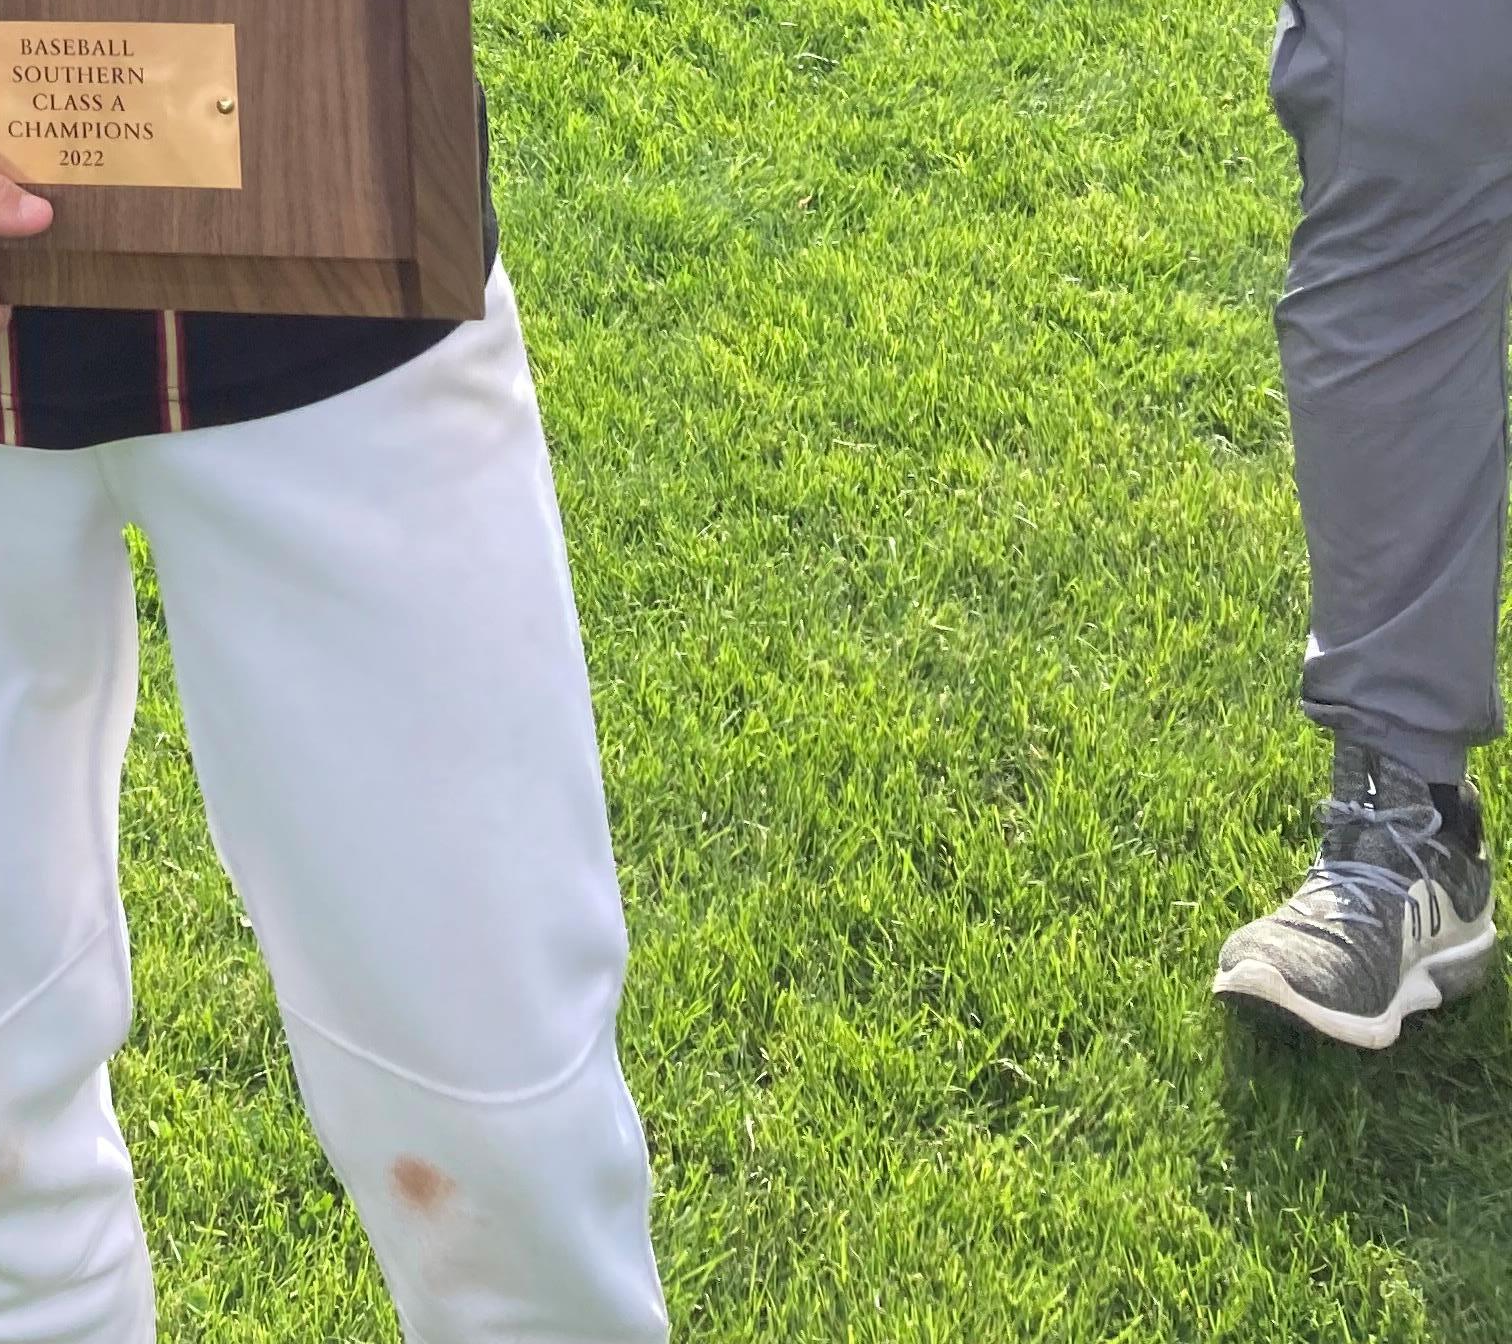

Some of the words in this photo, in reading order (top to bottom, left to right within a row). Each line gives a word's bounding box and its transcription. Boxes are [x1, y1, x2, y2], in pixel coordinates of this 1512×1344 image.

[20, 38, 135, 57] BASEBALL
[12, 65, 145, 84] SOUTHERN
[32, 94, 103, 112] CLASS
[110, 94, 126, 112] A
[7, 120, 155, 140] CHAMPIONS
[59, 150, 105, 167] 2022
